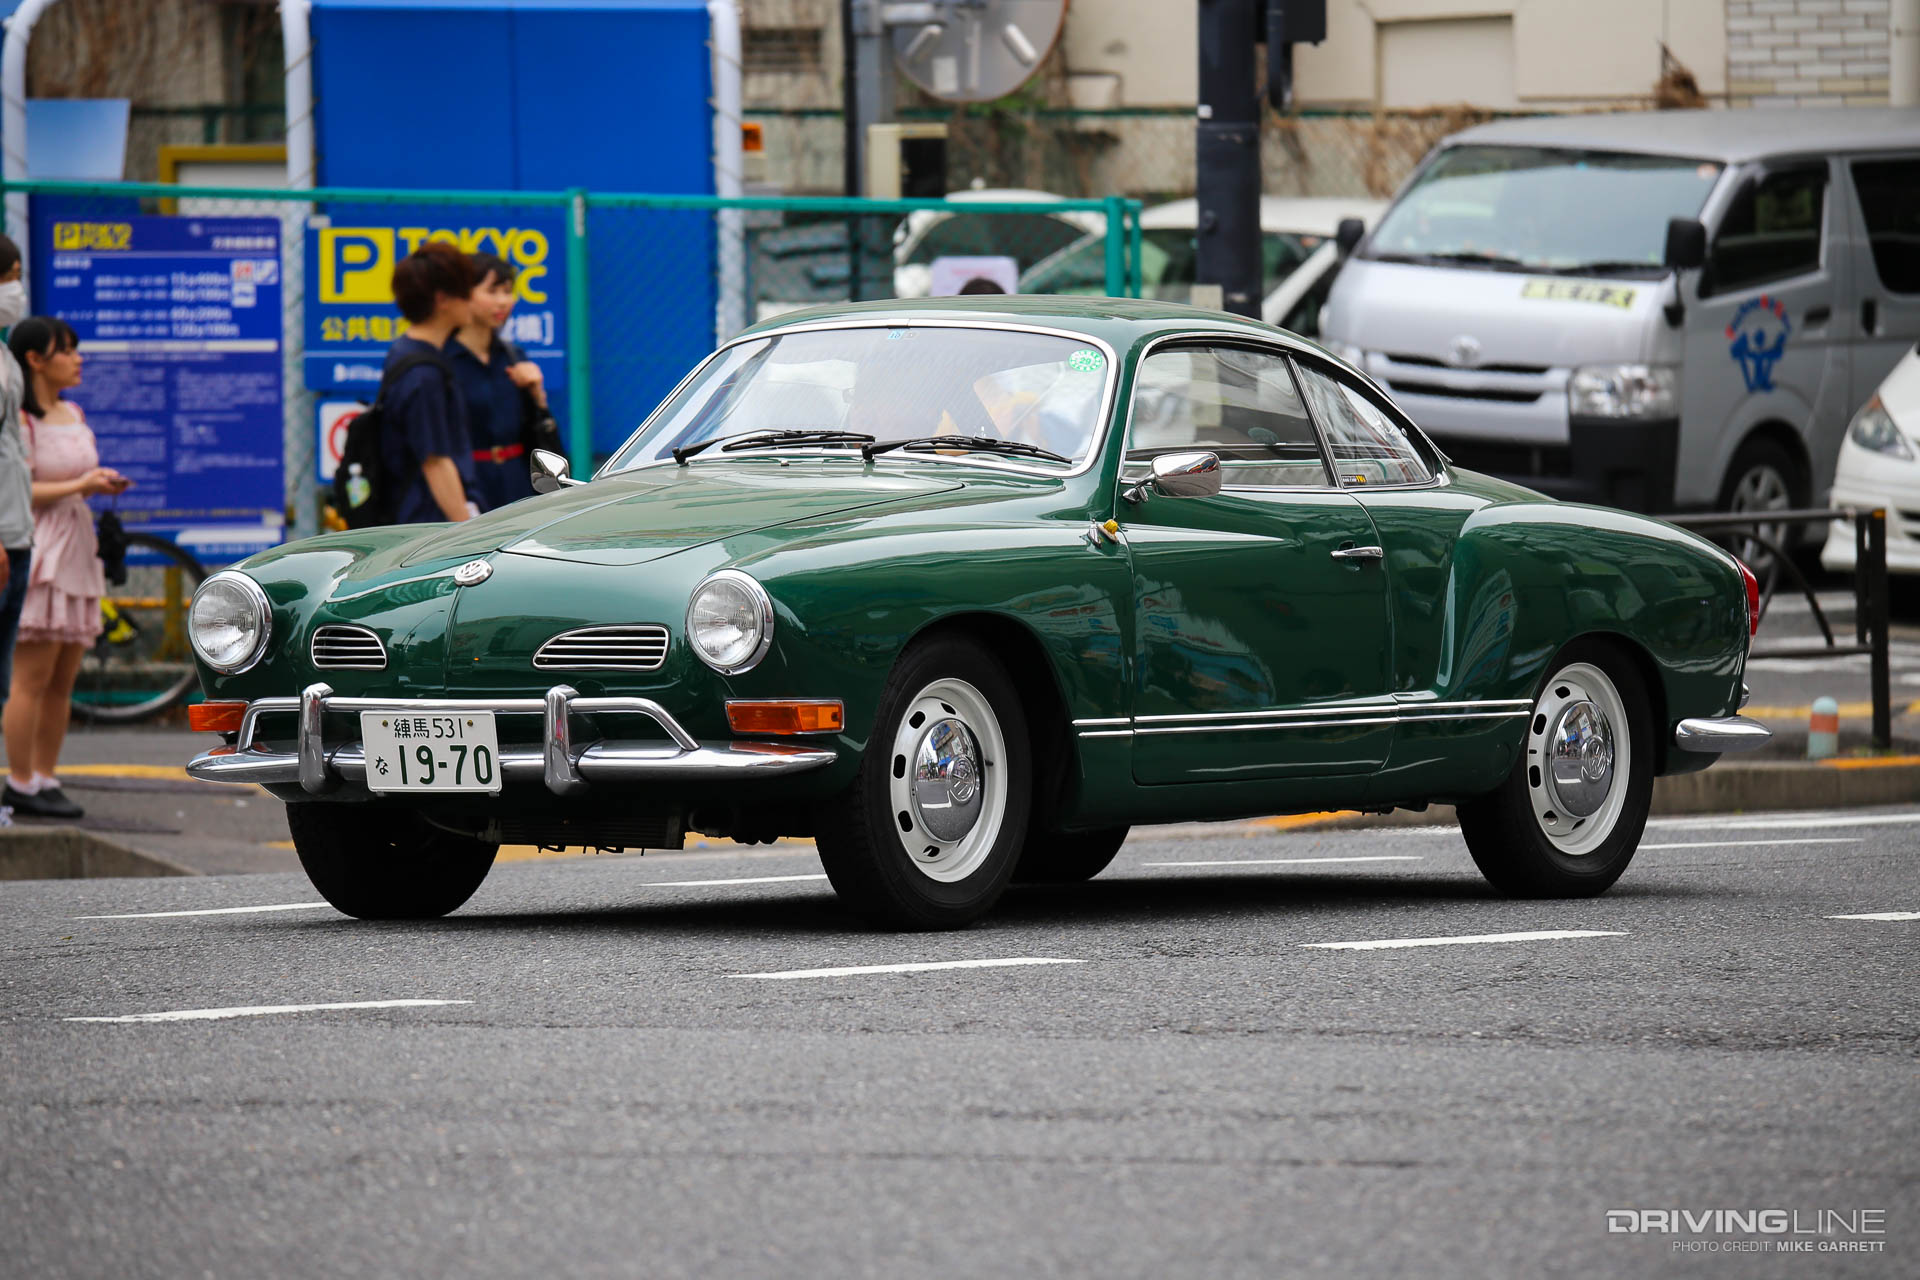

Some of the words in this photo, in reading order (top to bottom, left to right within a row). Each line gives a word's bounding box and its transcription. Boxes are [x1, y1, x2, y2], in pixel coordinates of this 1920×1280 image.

[334, 236, 380, 296] P
[394, 718, 430, 738] 練馬
[432, 718, 463, 738] 531
[375, 756, 389, 775] な
[399, 745, 493, 785] 19-70
